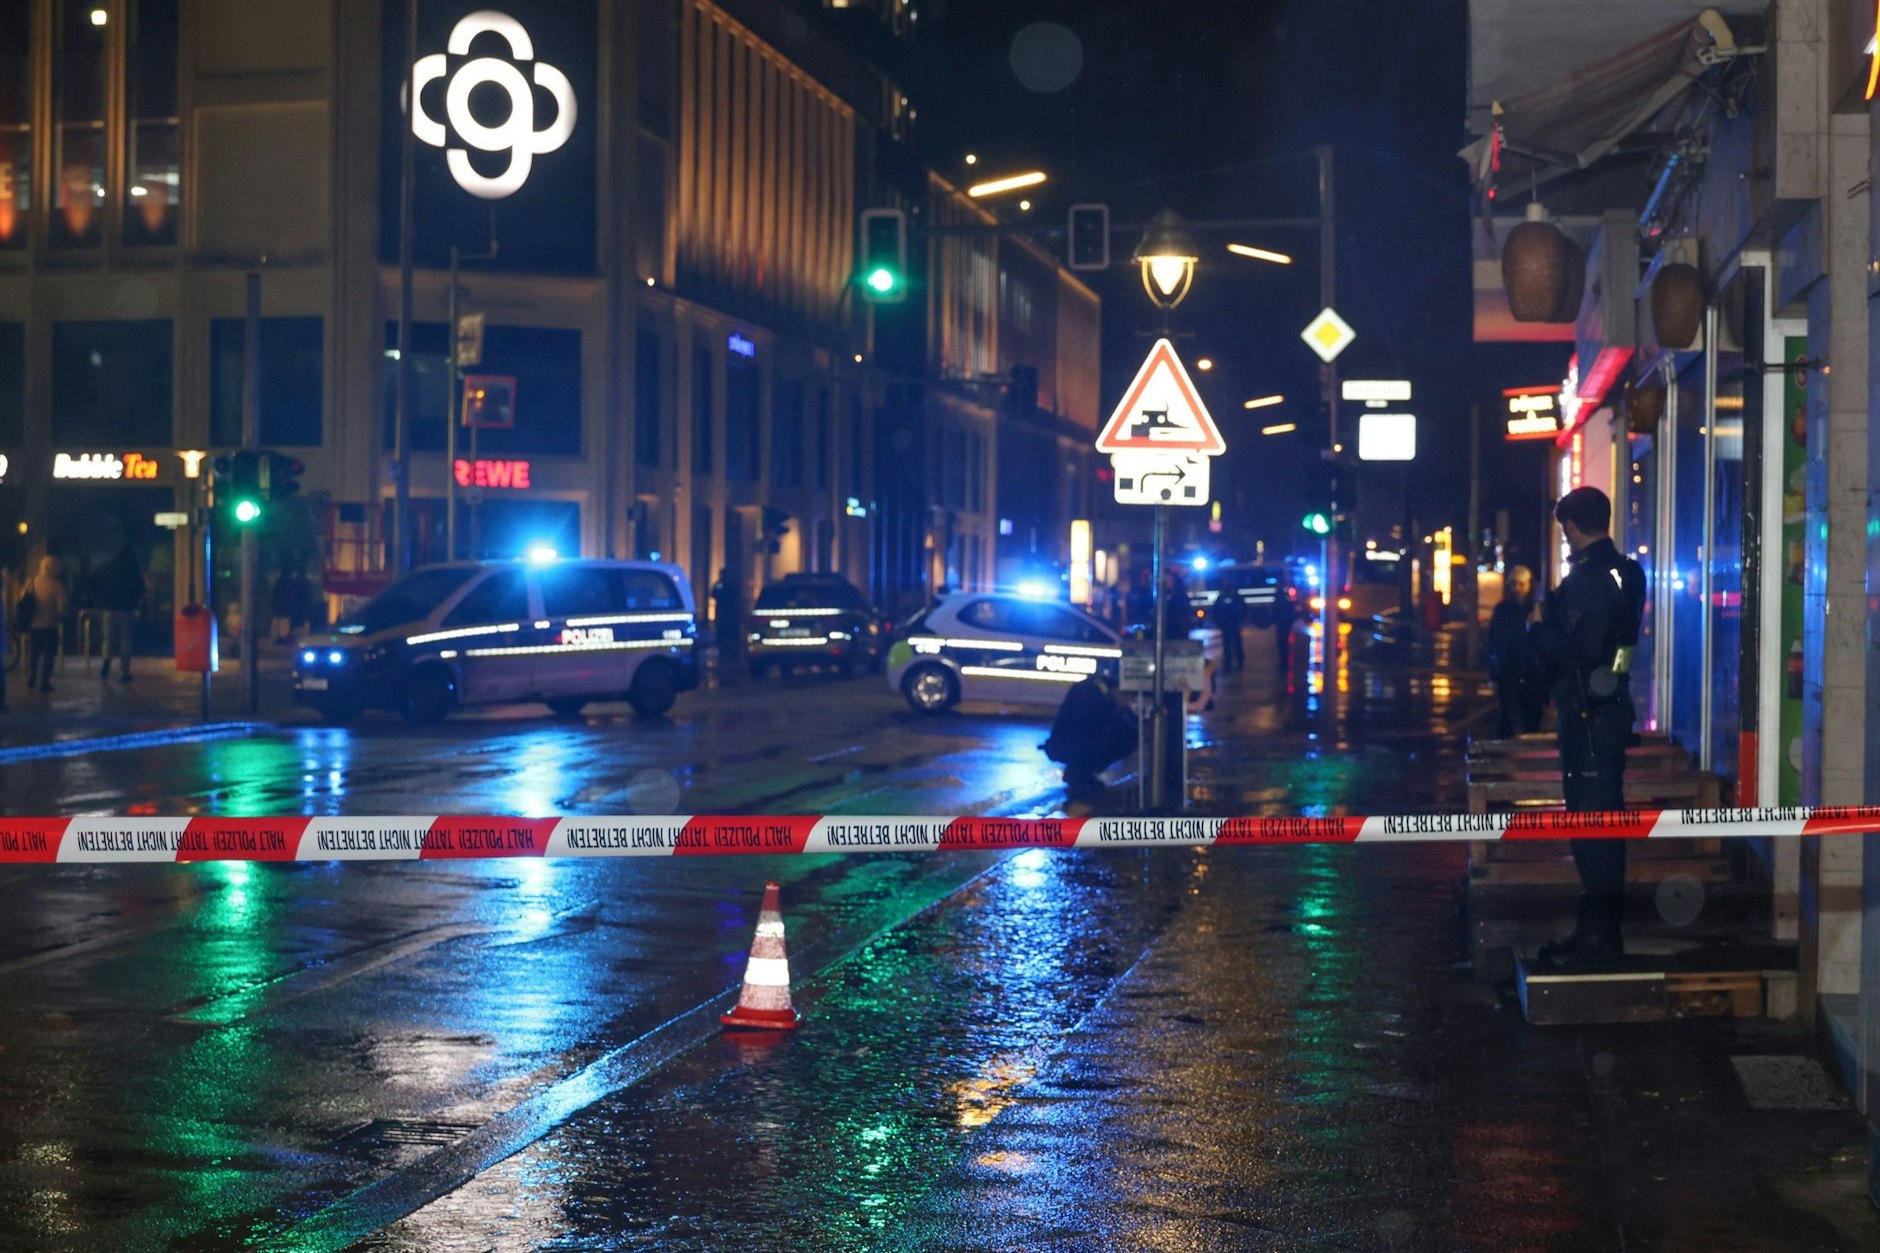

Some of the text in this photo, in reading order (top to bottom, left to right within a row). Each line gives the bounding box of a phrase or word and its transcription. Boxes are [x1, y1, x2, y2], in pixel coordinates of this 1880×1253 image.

[453, 459, 531, 488] REWE
[1208, 818, 1254, 839] TATORT
[1313, 816, 1346, 835] HALT
[1384, 814, 1453, 835] BETRETEN!
[1455, 813, 1495, 832] NICHT
[1498, 812, 1545, 831] TATORT
[1608, 810, 1642, 826] HALT
[318, 830, 377, 851] BETRETEN!
[379, 830, 412, 851] NICHT
[414, 830, 454, 850] TATORT
[459, 829, 503, 850] POLIZEI!
[507, 828, 535, 849] HALT
[567, 828, 628, 849] BETRETEN!
[632, 827, 665, 848] NICHT
[668, 827, 710, 848] TATORT
[715, 826, 761, 847] POLIZEI!
[764, 825, 793, 846] HALT
[827, 825, 891, 846] BETRETEN!
[894, 824, 929, 845] NICHT
[933, 822, 976, 845] TATORT
[980, 822, 1029, 844] POLIZEI!
[1032, 822, 1063, 842] HALT
[1100, 820, 1166, 842] BETRETEN!
[1168, 819, 1205, 841] NICHT
[21, 831, 48, 851] HALT
[78, 831, 135, 851] BETRETEN!
[136, 831, 169, 851] NICHT
[170, 831, 209, 851] TATORT
[213, 831, 257, 851] POLIZEI!
[259, 831, 287, 851] HALT
